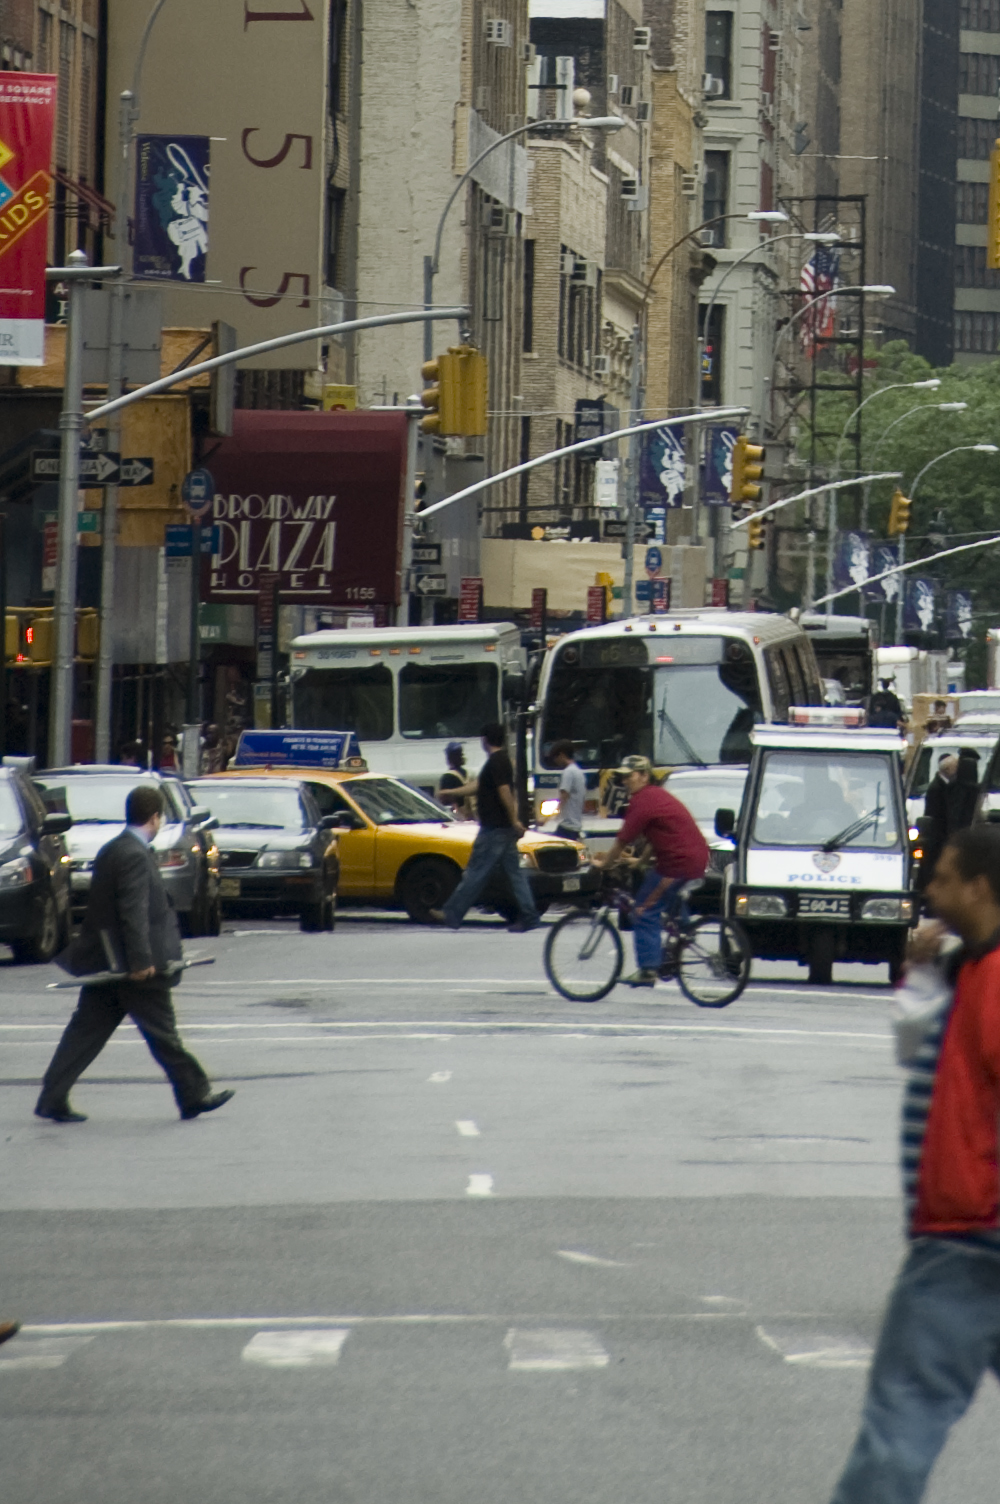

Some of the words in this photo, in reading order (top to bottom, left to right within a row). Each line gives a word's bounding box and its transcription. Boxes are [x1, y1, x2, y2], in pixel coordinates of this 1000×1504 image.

[7, 85, 52, 95] SQUARE
[212, 494, 336, 519] BROADWAY
[211, 520, 337, 572] PLAZA
[210, 573, 330, 587] HOEL
[787, 873, 862, 885] POLICE
